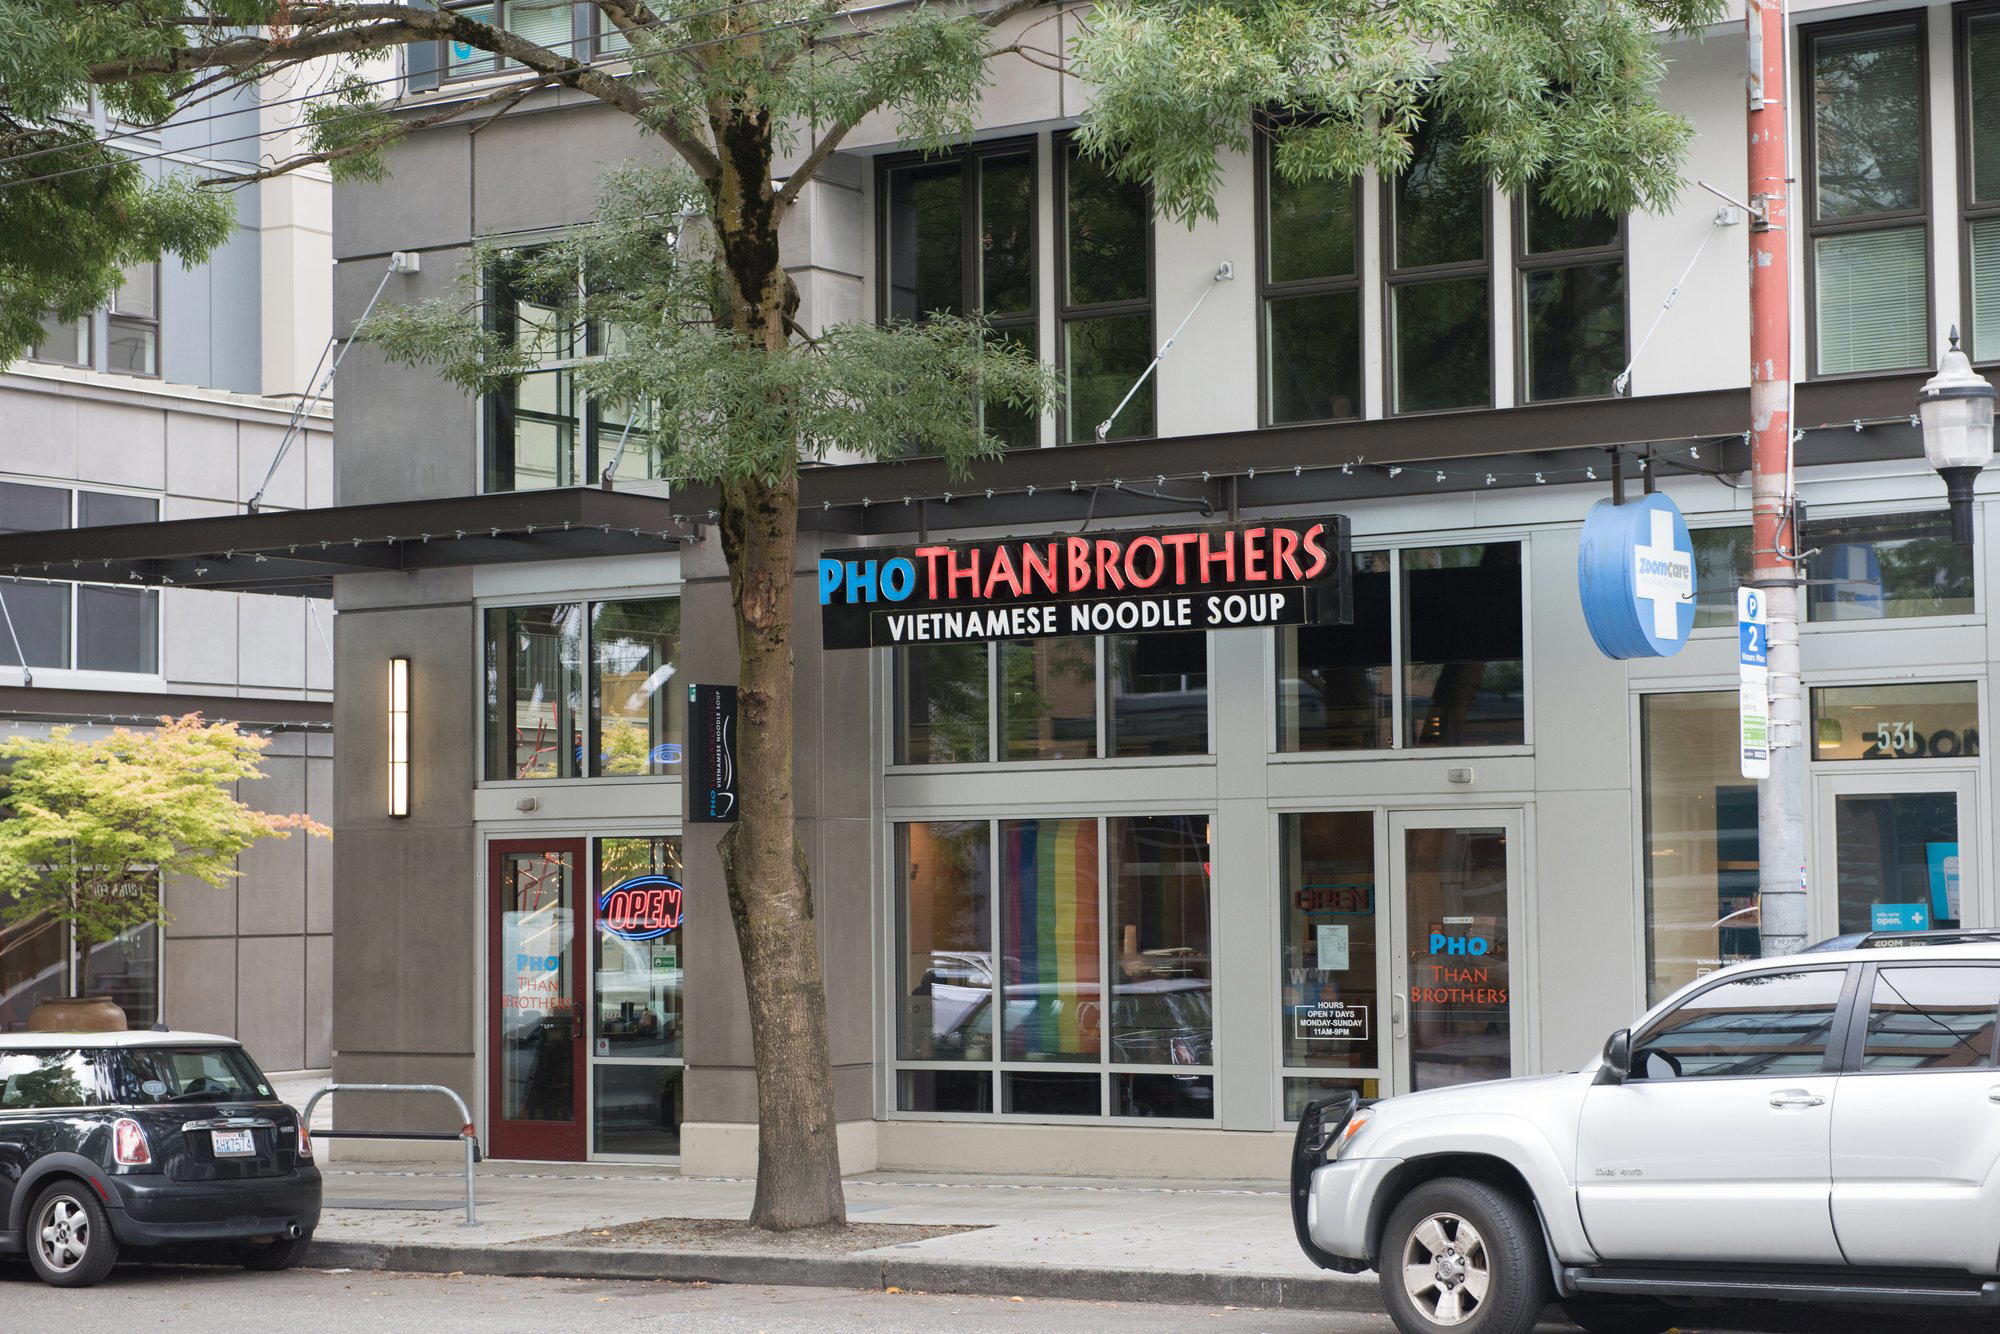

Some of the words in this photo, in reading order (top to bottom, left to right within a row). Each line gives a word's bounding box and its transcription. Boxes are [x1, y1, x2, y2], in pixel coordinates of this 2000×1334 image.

[818, 557, 915, 605] PHO
[887, 606, 1057, 641] VIETNAMESE
[1071, 598, 1192, 631] NOODLE
[1207, 593, 1286, 624] SOUP
[1748, 625, 1758, 651] 2
[1877, 722, 1914, 750] 531
[1295, 888, 1369, 911] OPEN
[608, 889, 681, 930] OPEN
[1430, 933, 1488, 956] PHO
[516, 953, 559, 971] PHO
[1431, 966, 1488, 982] THAN
[517, 976, 559, 992] THAN
[502, 994, 571, 1009] BROTHERS
[1411, 986, 1507, 1003] BROTHERS
[1317, 1001, 1344, 1009] HOURS
[1307, 1010, 1328, 1018] OPEN
[1335, 1010, 1355, 1018] DAYS
[1300, 1019, 1363, 1027] MONDAY-SUNDAY
[1314, 1028, 1350, 1036] 11AM-9PM
[216, 1136, 252, 1152] AHX7574
